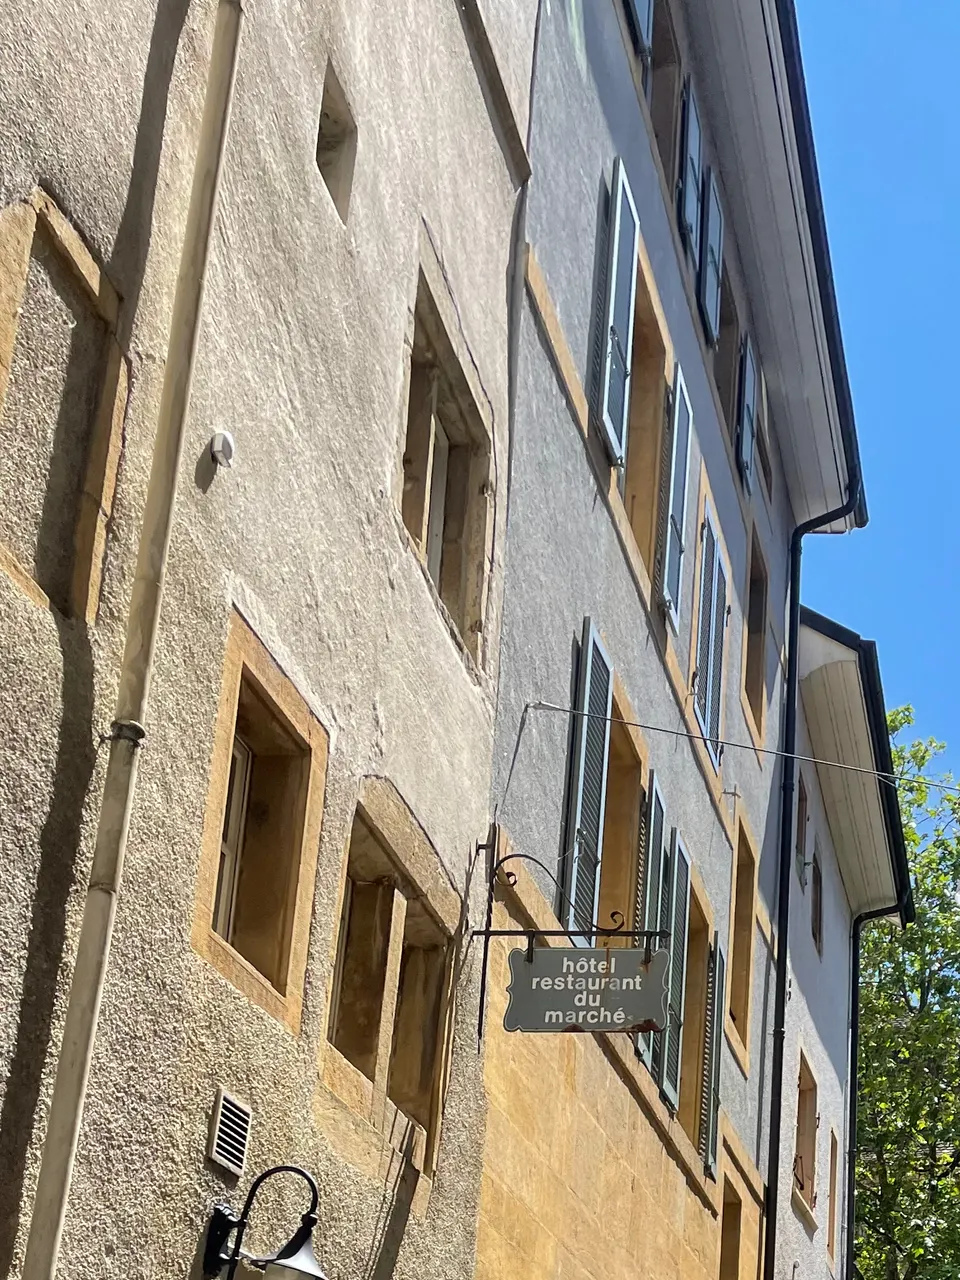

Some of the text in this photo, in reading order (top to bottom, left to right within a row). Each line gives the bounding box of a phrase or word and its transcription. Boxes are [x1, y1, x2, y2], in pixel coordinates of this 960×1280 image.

[562, 956, 616, 974] hôtel
[531, 974, 642, 990] restaurant
[574, 990, 600, 1007] du
[544, 1007, 625, 1024] marché
